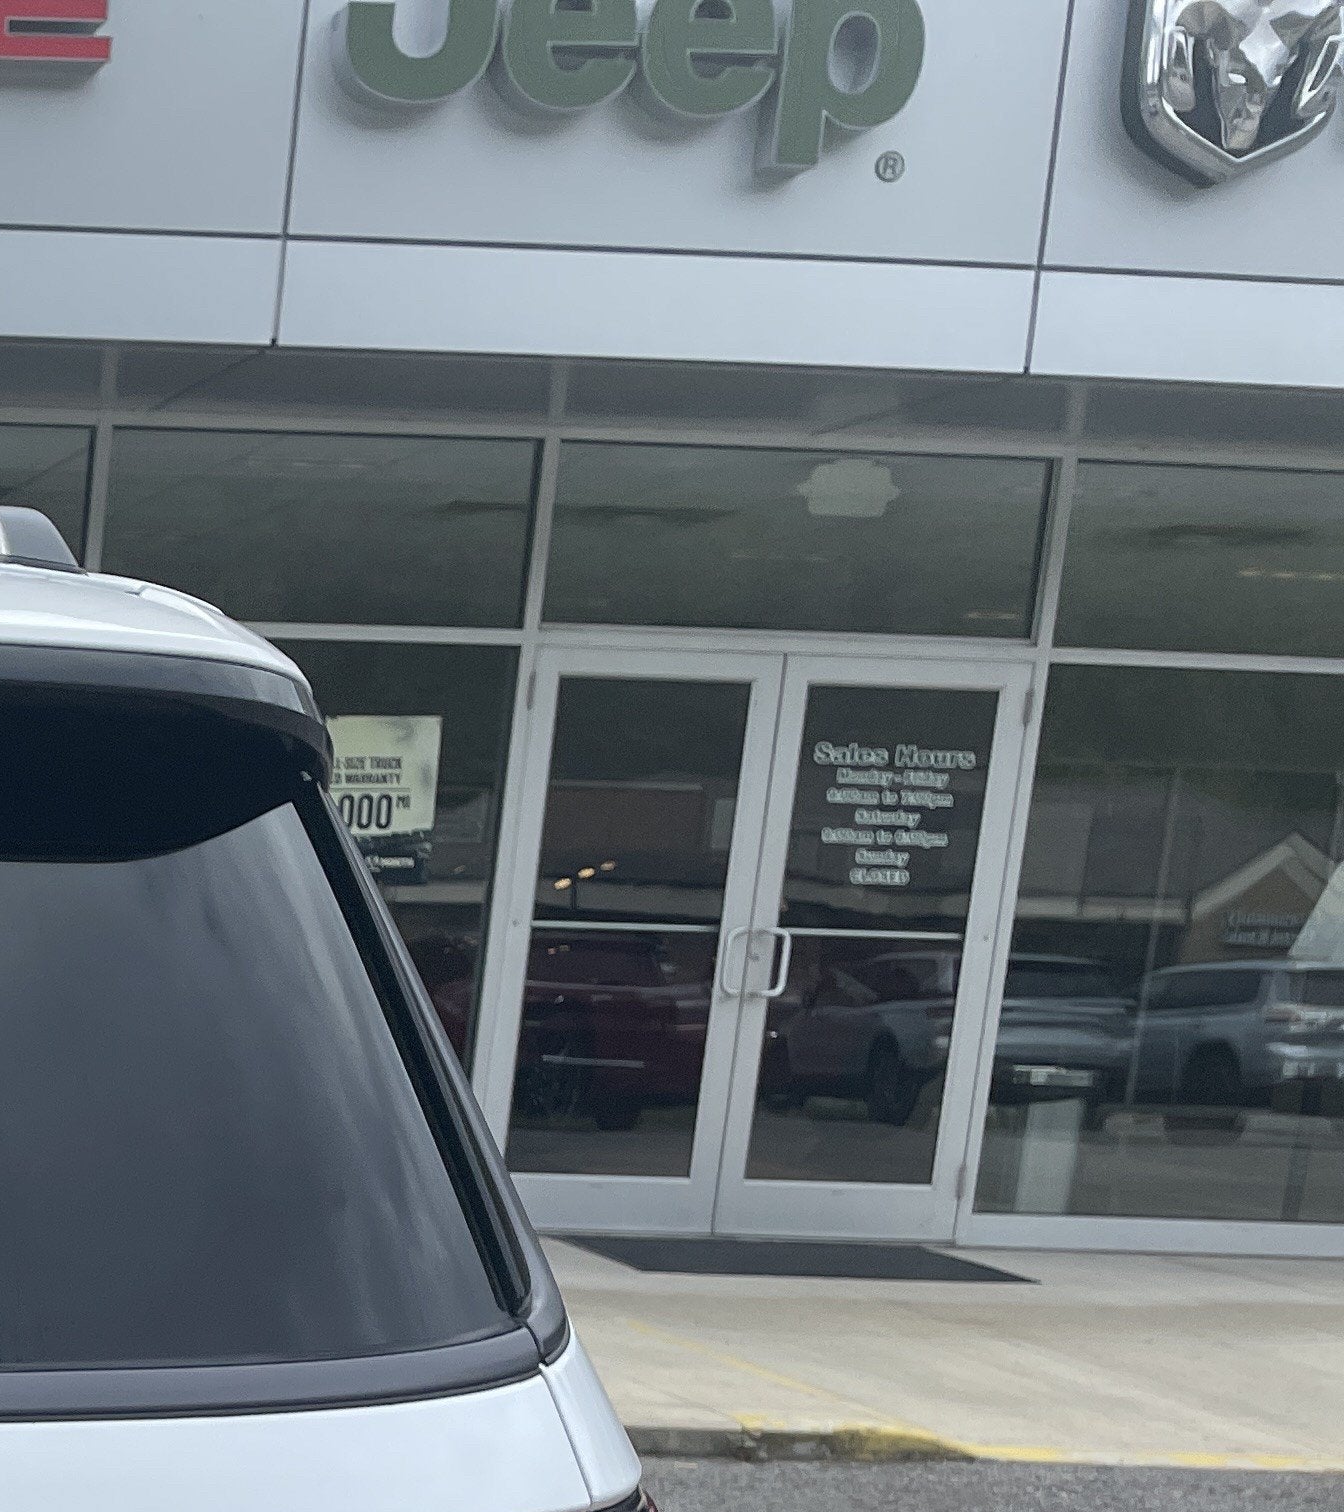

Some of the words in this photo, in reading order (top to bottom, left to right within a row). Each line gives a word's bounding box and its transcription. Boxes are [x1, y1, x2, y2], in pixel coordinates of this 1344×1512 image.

[813, 741, 889, 767] Sales
[895, 744, 977, 769] Hours
[849, 868, 910, 886] CLOSED
